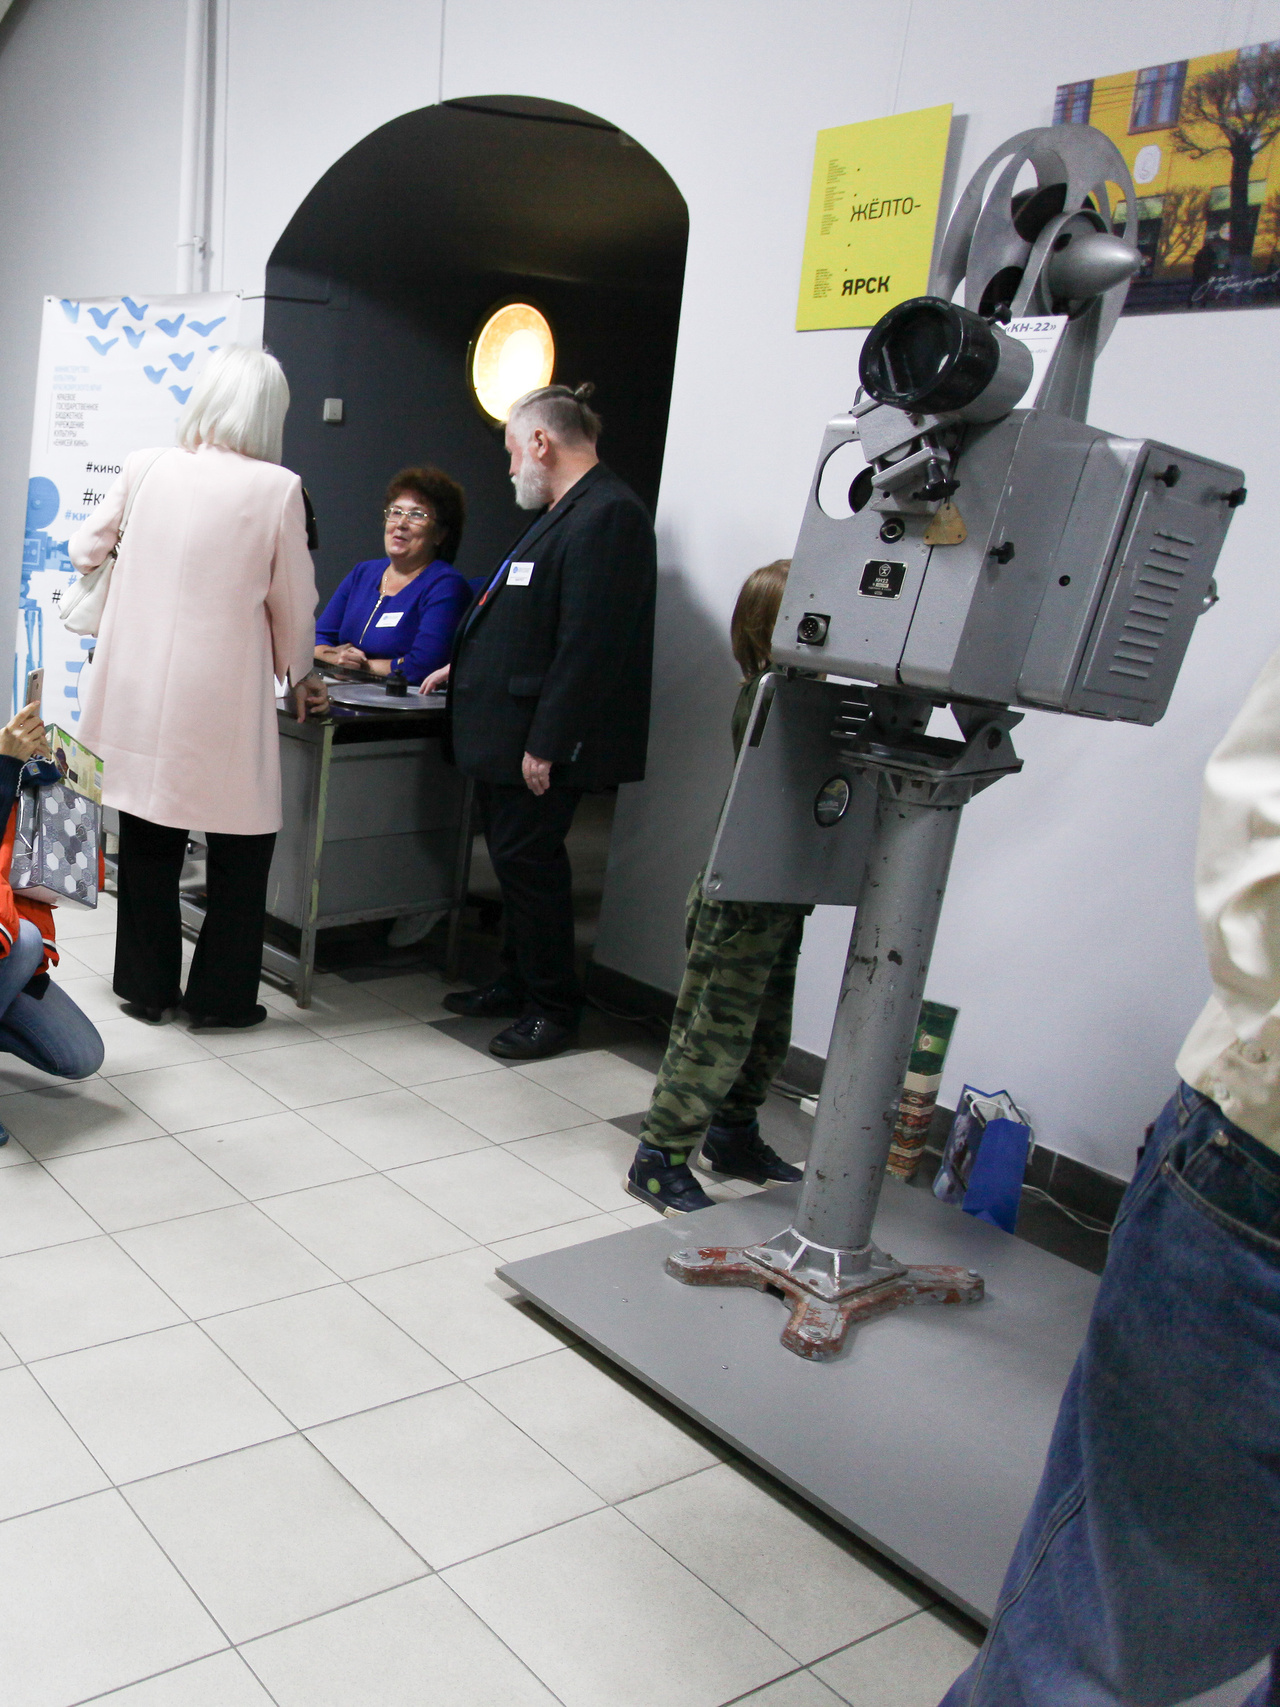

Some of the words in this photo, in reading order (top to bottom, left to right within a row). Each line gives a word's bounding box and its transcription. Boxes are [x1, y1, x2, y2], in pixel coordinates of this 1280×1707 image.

[850, 197, 921, 222] ЖЁЛТО-
[841, 275, 891, 296] ЯРСК
[86, 461, 123, 474] #кино
